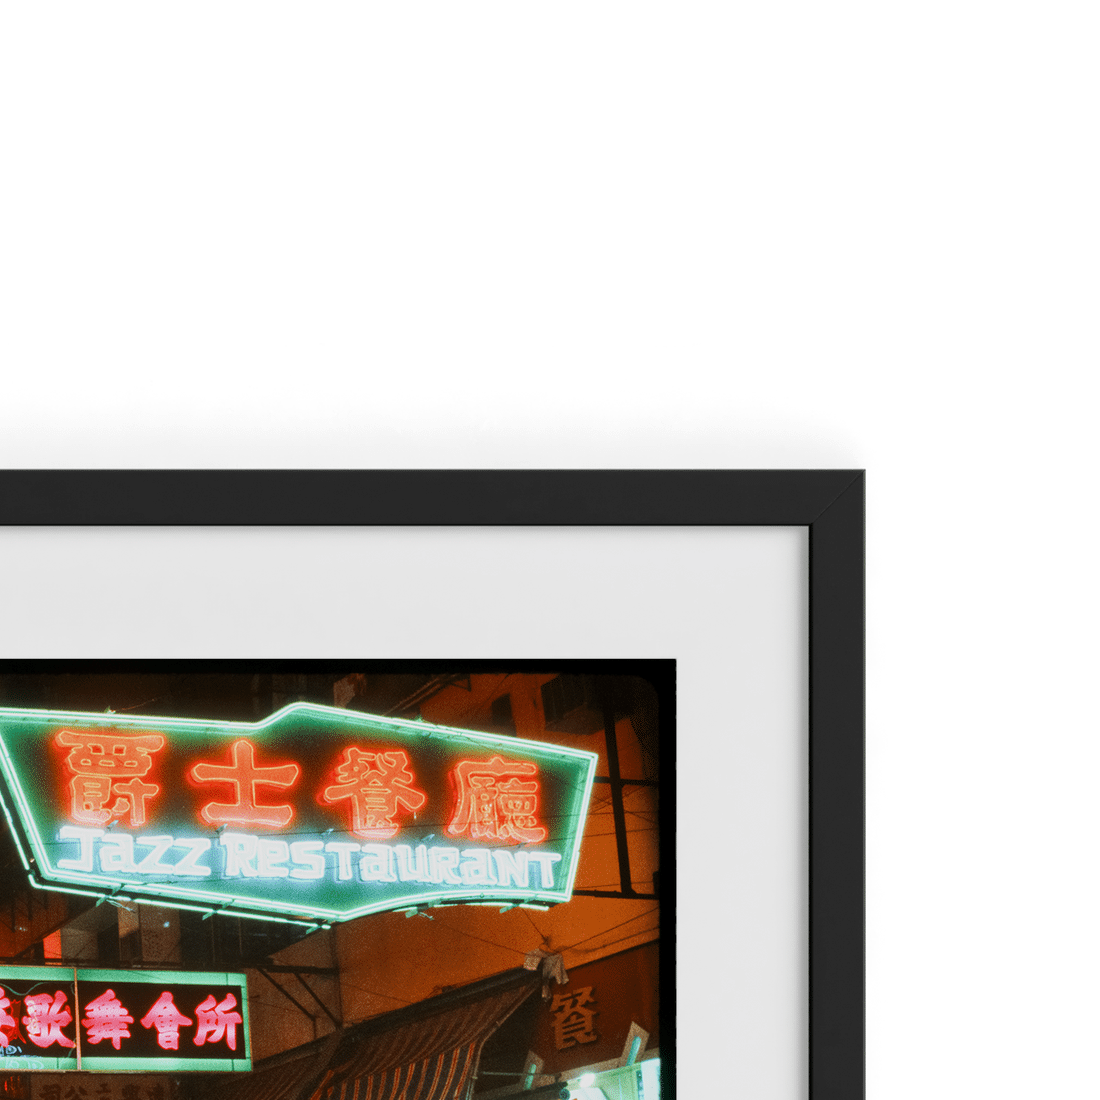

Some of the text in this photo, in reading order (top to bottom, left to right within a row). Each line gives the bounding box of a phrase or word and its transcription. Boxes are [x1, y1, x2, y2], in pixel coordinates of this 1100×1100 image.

[55, 729, 550, 845] 爵士餐廳
[56, 824, 213, 878] Jazz
